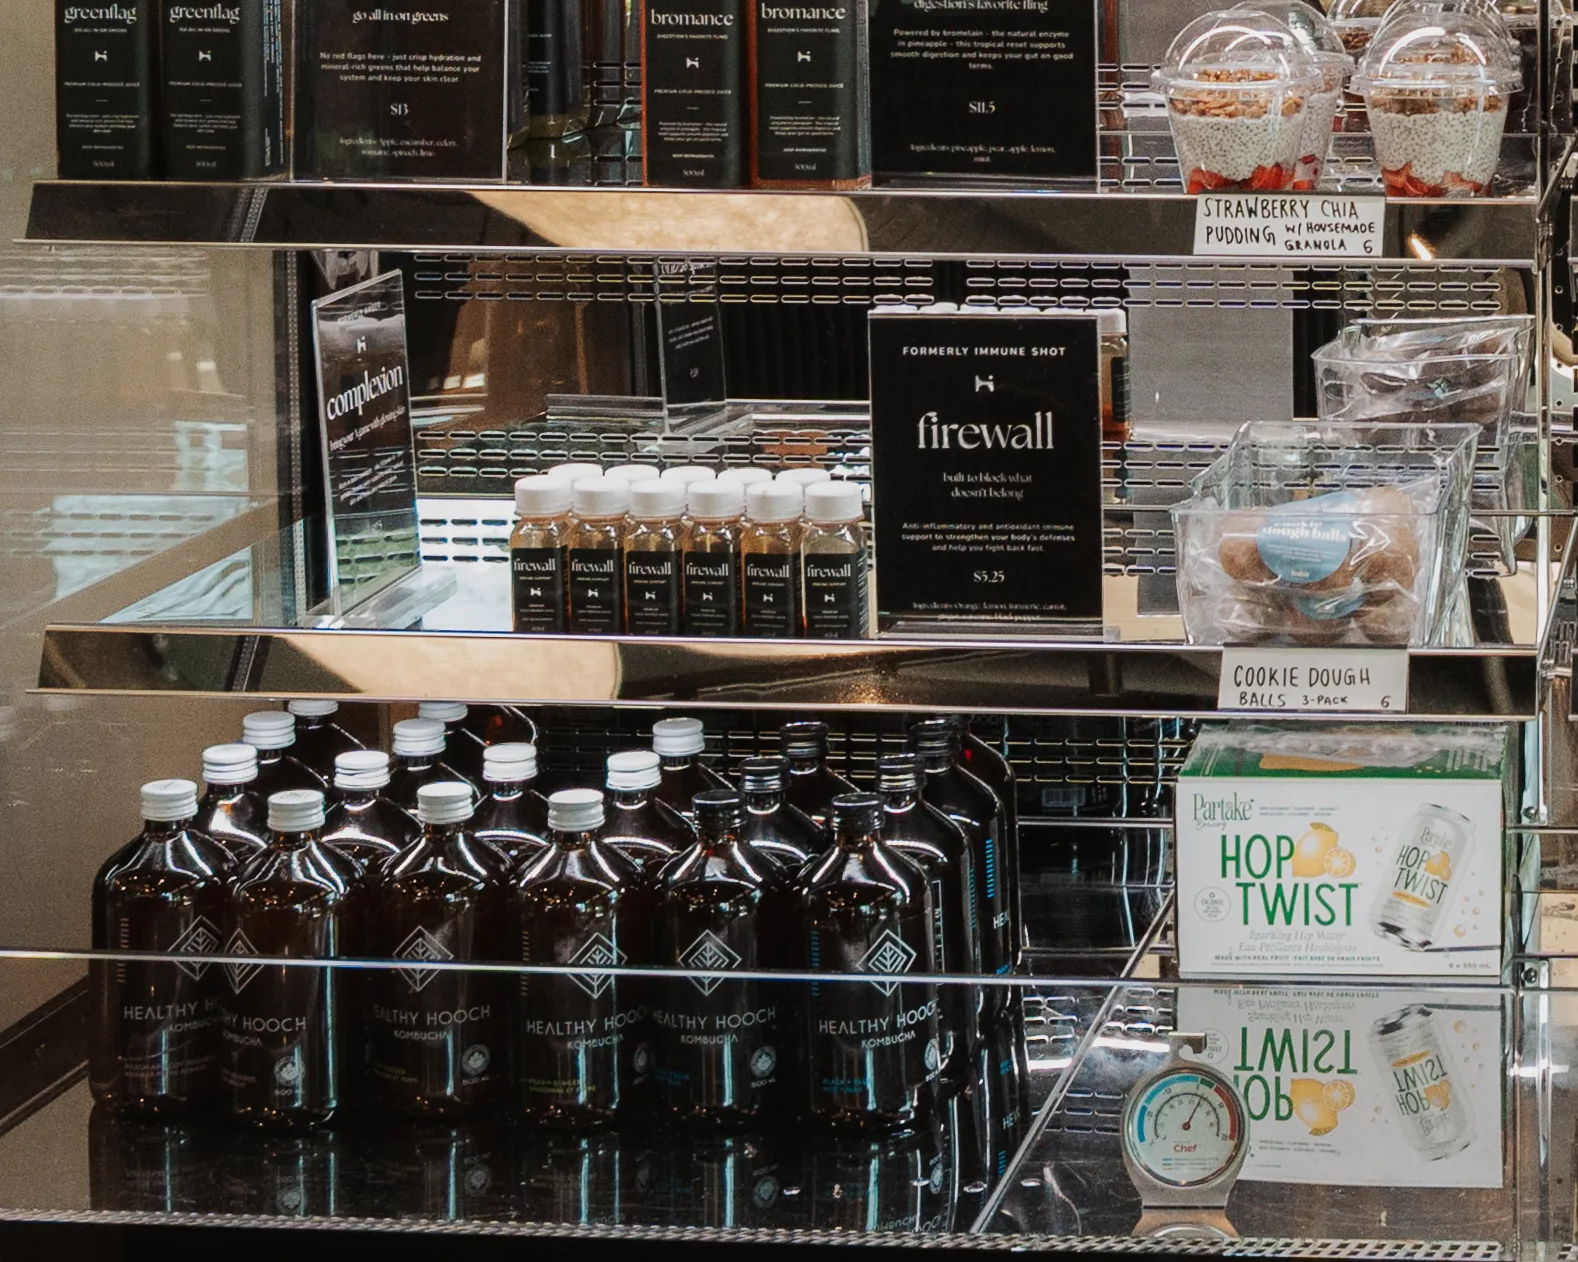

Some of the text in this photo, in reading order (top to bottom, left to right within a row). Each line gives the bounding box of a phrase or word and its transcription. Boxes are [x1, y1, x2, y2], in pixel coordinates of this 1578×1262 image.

[761, 2, 846, 20] bromance
[1203, 197, 1359, 219] STRAWBERRY CHIA
[1205, 225, 1276, 246] PUDDING
[1285, 238, 1373, 253] GRANOLA 6
[902, 346, 1066, 357] FORMERLY IMMUNE SHOT
[326, 361, 404, 422] complexion
[917, 411, 1054, 450] firewall
[807, 562, 852, 578] firewall
[1233, 665, 1371, 688] COOKIE DOUGH
[1239, 692, 1391, 708] BALLS 3-PACK 6
[1192, 792, 1255, 821] Partake
[1219, 834, 1294, 880] HOP
[1395, 844, 1429, 869] HOP
[1392, 867, 1449, 906] TWIST
[1235, 882, 1363, 927] TWIST
[242, 1017, 307, 1032] HOOCH
[426, 1004, 492, 1026] HOOCH
[527, 1018, 597, 1035] HEALTHY
[1173, 1143, 1198, 1154] Chef
